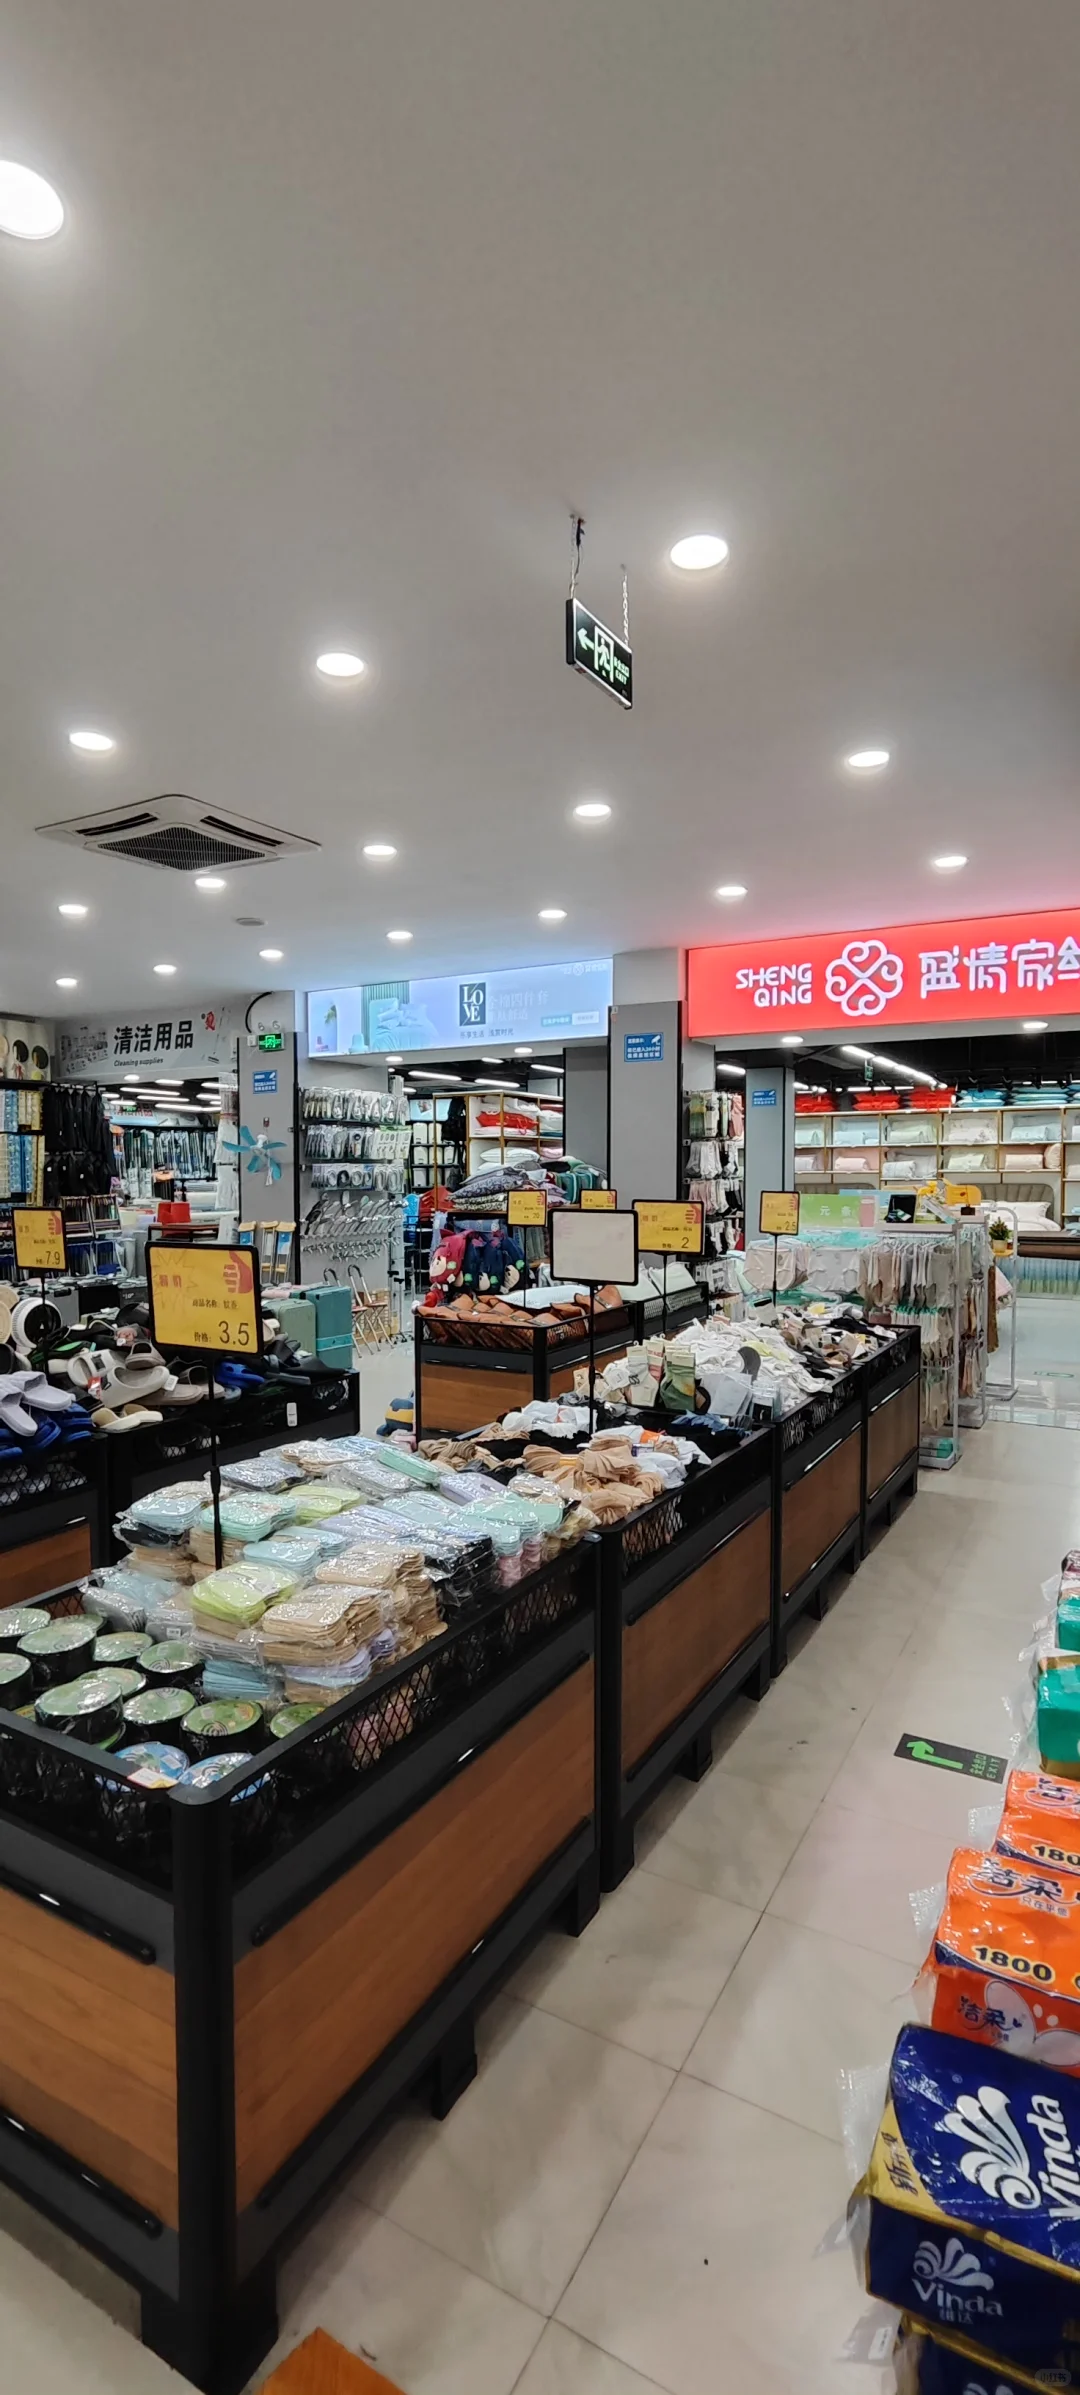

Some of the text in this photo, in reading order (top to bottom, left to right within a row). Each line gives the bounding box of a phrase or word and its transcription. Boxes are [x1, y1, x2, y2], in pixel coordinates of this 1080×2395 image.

[615, 669, 627, 685] EXIT
[735, 963, 812, 989] SHENG
[753, 985, 812, 1008] QING
[113, 1020, 194, 1055] 清洁用品
[113, 1057, 164, 1067] Cleaning supplies
[820, 1206, 831, 1216] 元
[681, 1236, 690, 1249] 2
[45, 1251, 60, 1265] 7.9
[218, 1320, 250, 1346] 3.5
[986, 1758, 1000, 1779] EXIT
[974, 1947, 1053, 1982] 1800
[1026, 2094, 1080, 2219] Vinda
[911, 2277, 1003, 2317] Vinda
